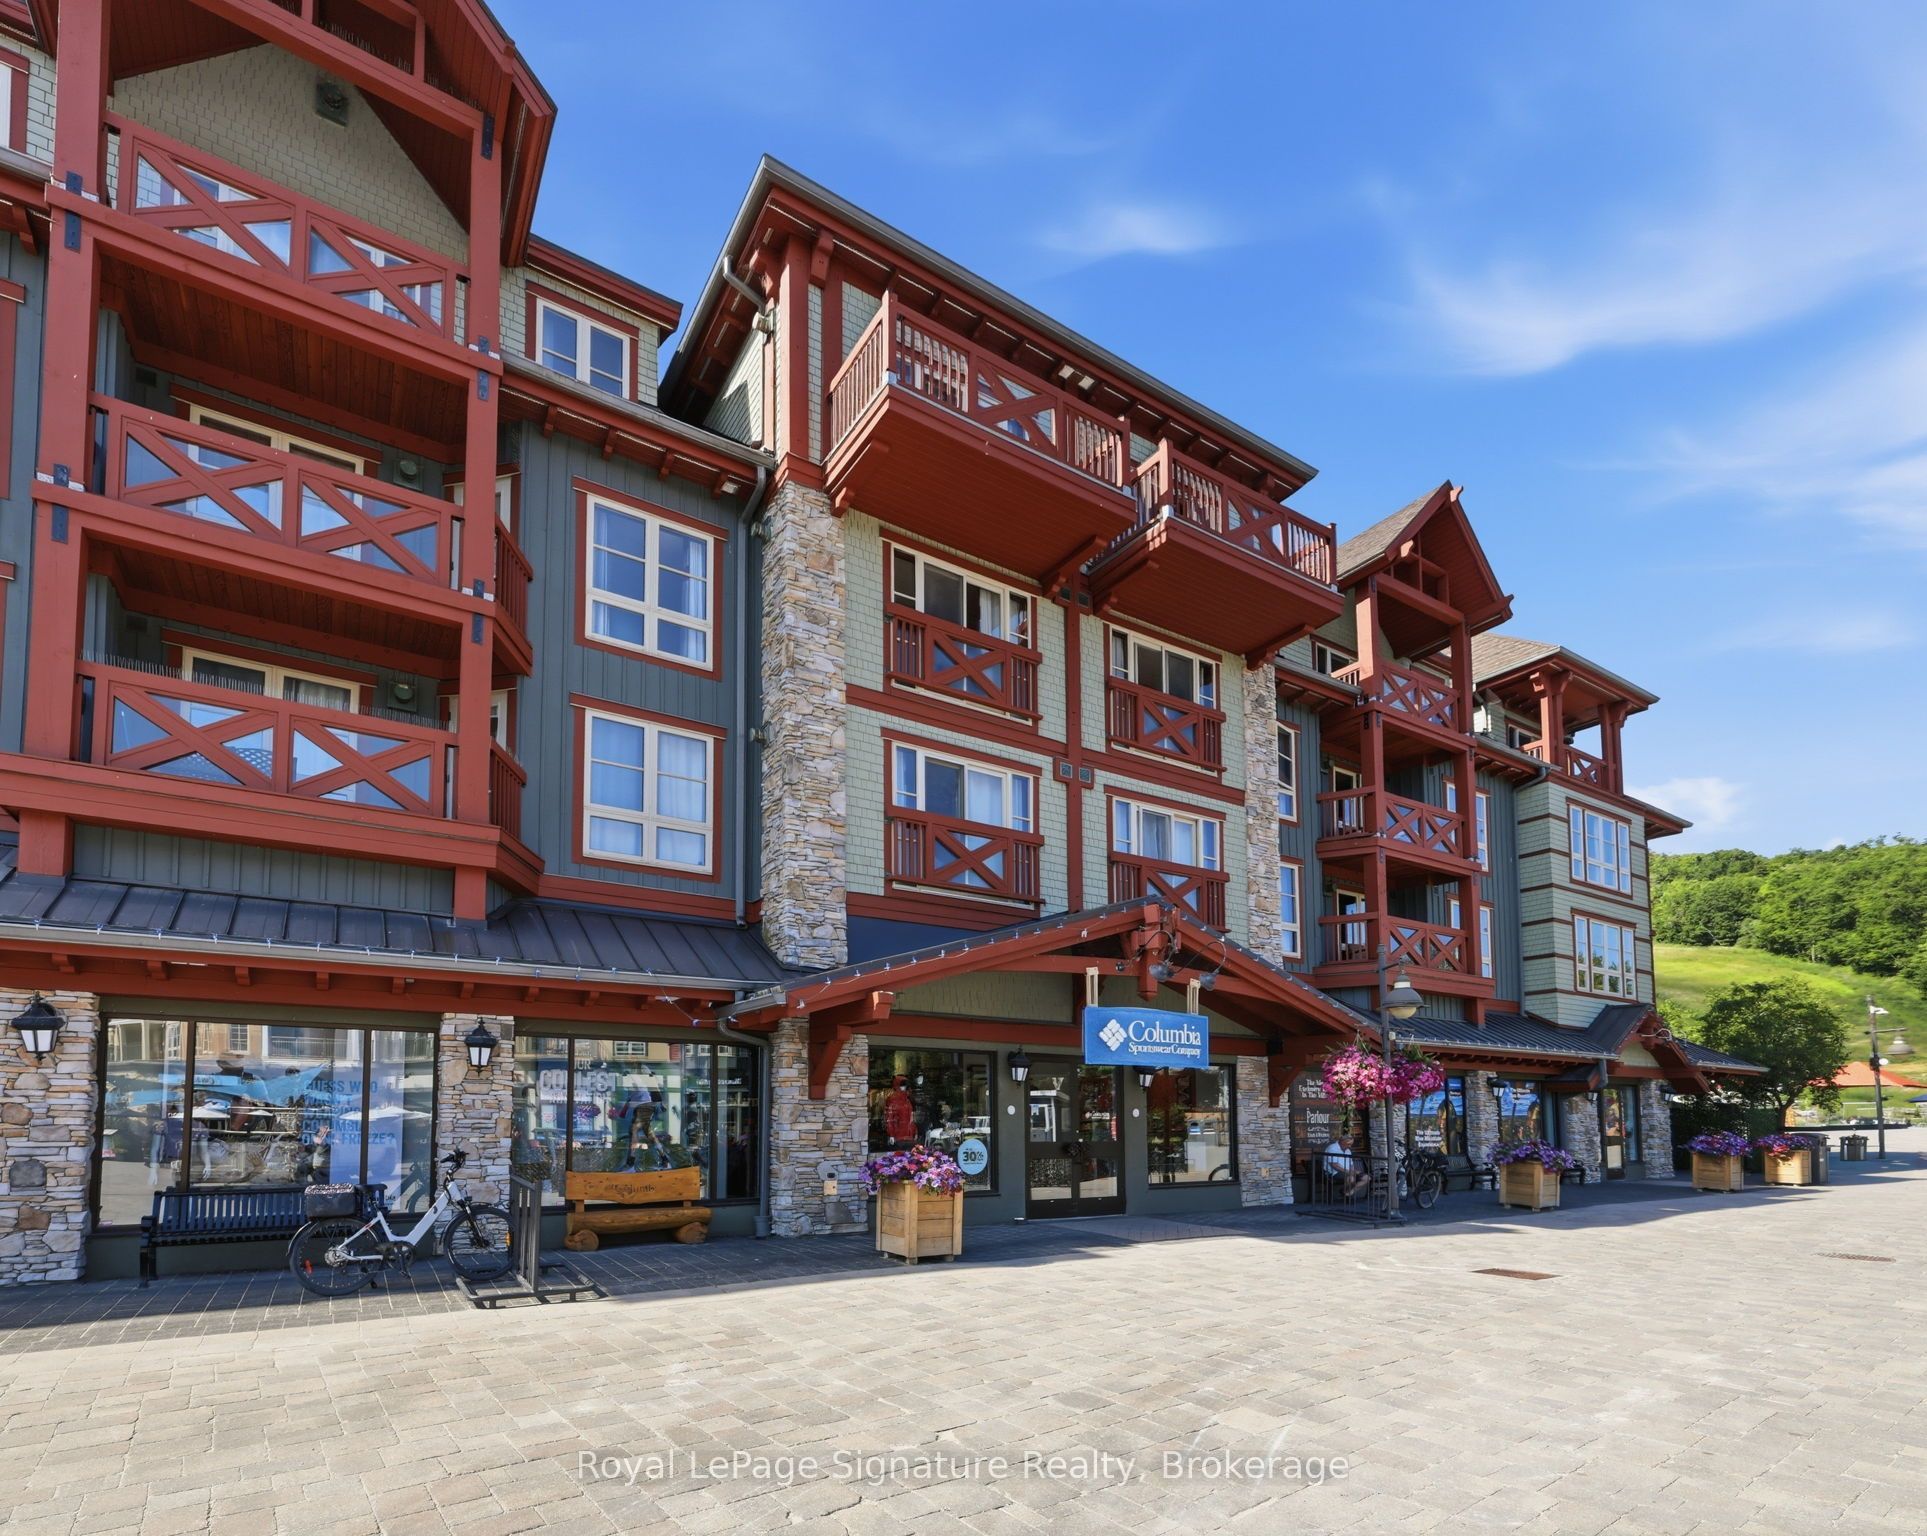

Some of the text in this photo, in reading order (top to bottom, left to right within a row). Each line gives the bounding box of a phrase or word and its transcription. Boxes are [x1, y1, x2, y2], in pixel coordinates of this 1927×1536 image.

[1128, 1020, 1201, 1045] Columbia
[1128, 1042, 1201, 1058] Sportswear Company
[349, 1080, 378, 1093] WO
[1306, 1110, 1330, 1124] Parlour
[962, 1151, 984, 1162] 30%
